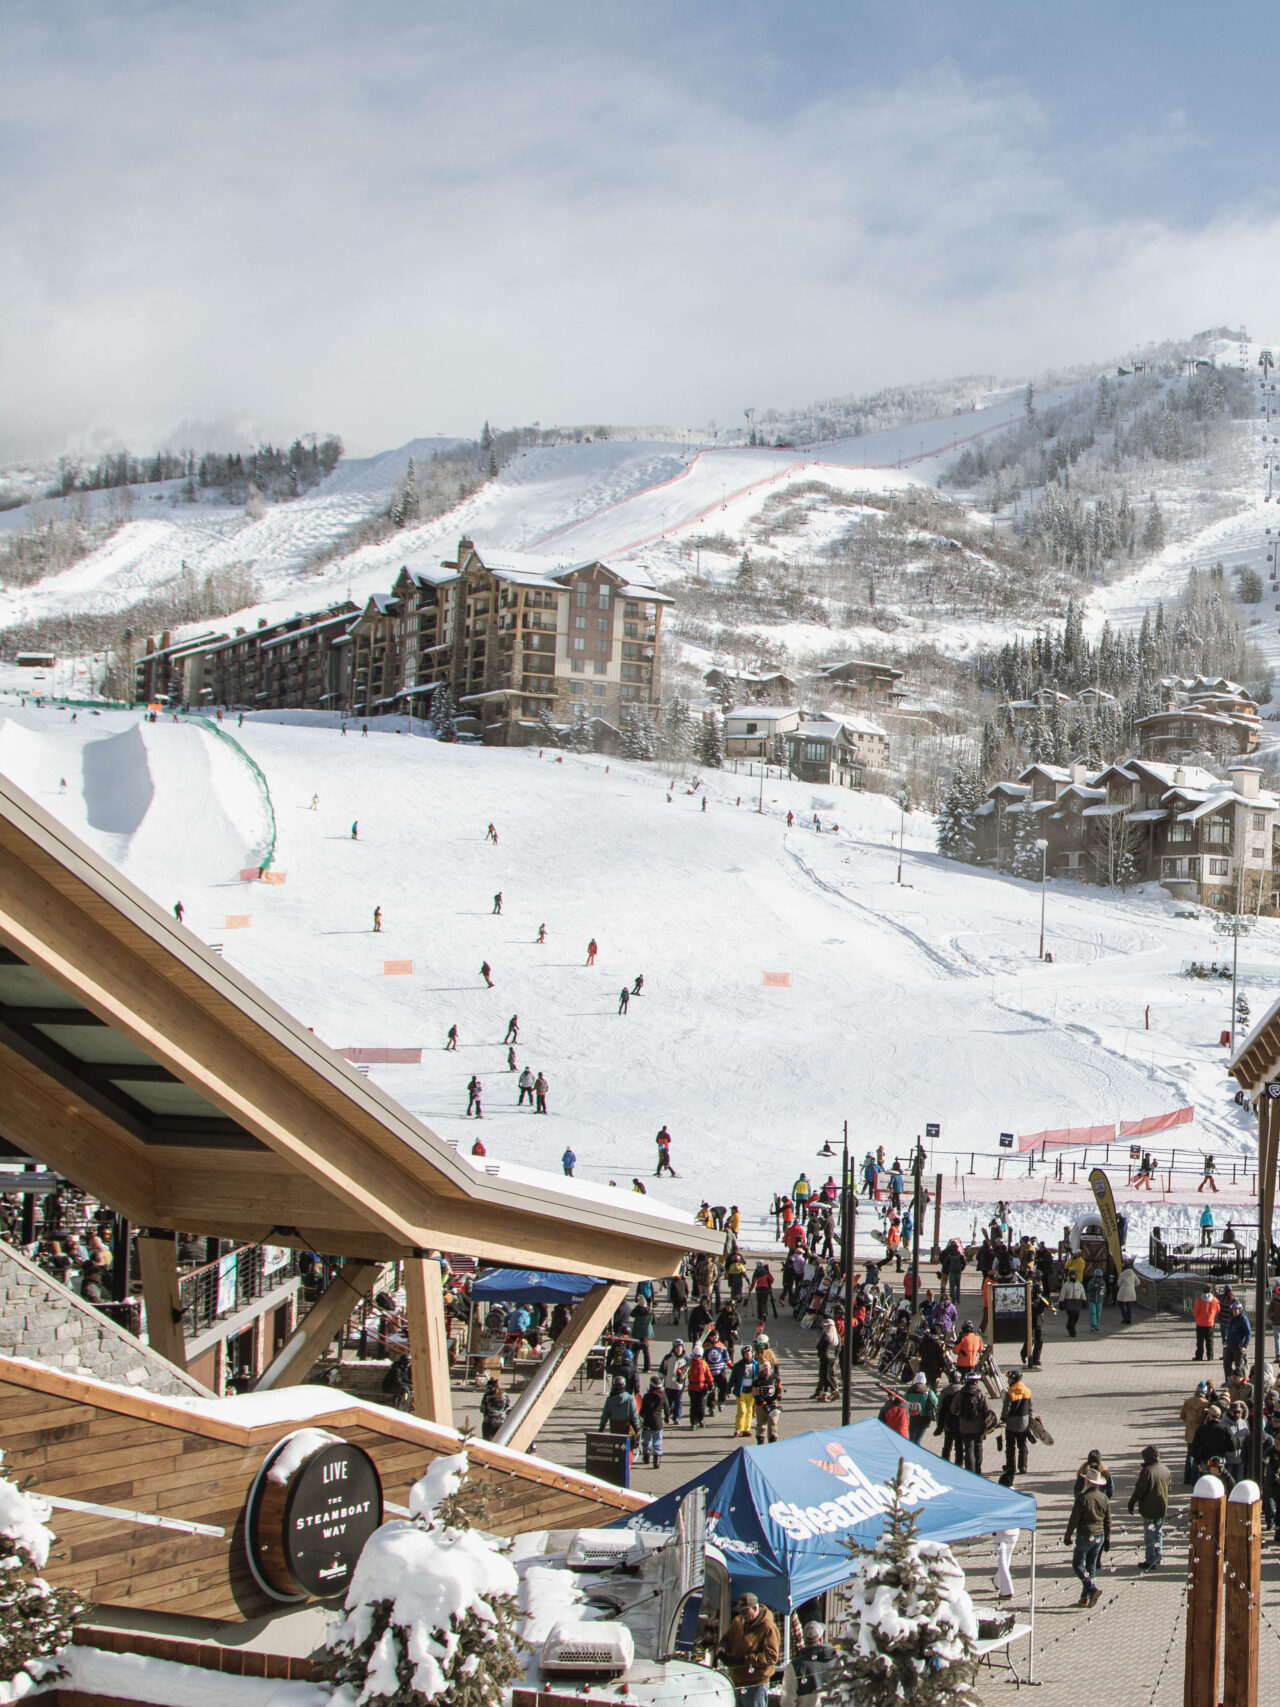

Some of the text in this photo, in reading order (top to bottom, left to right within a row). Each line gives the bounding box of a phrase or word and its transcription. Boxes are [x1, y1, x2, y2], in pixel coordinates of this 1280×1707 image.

[323, 1461, 348, 1484] LIVE
[327, 1496, 342, 1505] THE
[296, 1501, 371, 1530] STEAMBOAT
[322, 1525, 346, 1539] WAY
